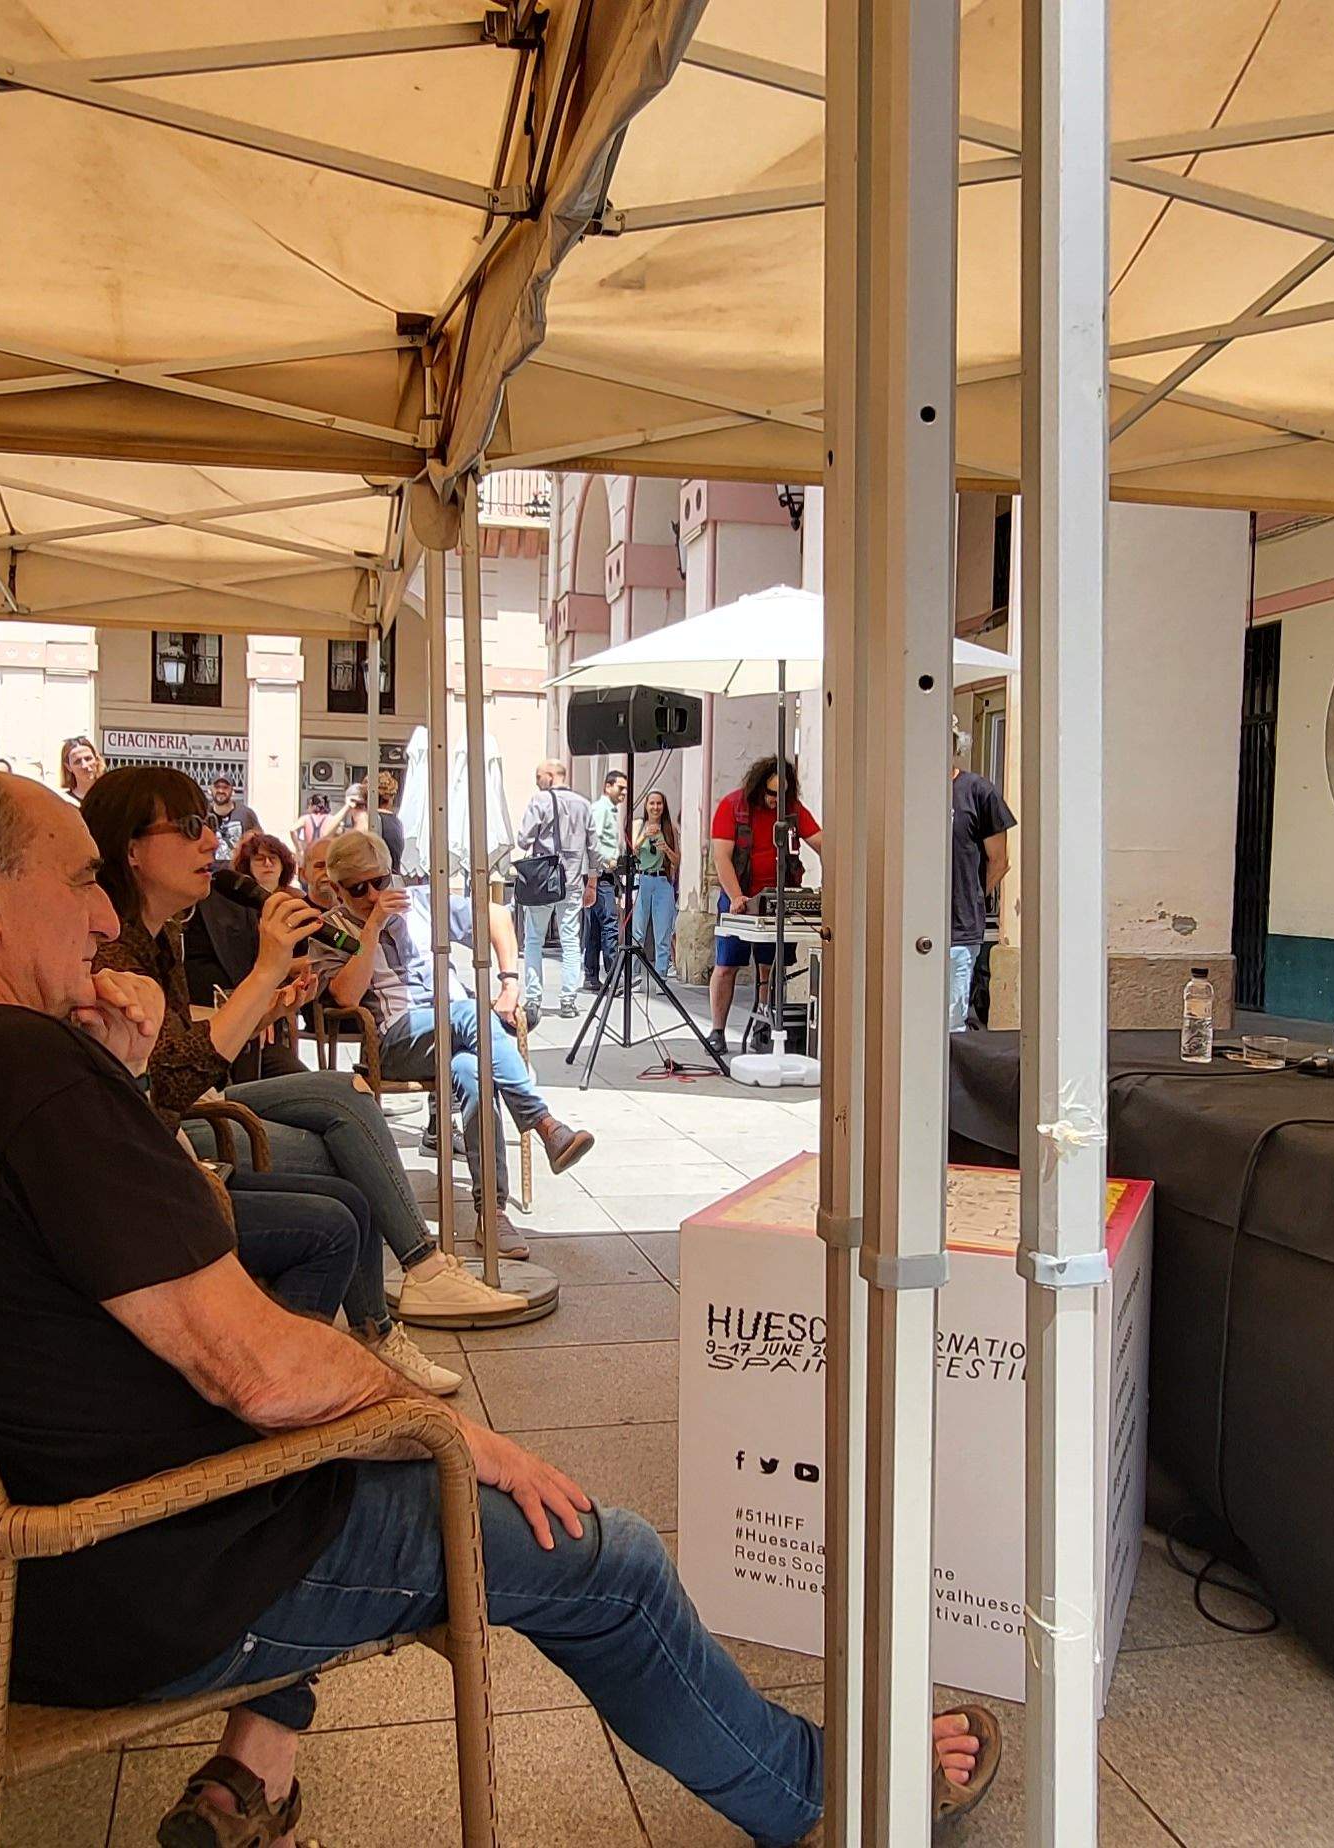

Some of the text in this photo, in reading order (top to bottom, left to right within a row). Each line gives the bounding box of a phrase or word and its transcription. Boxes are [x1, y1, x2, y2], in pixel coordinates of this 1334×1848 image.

[108, 732, 188, 750] CHACINERIA
[708, 1303, 826, 1344] HUESC
[706, 1340, 751, 1357] 9-17
[756, 1343, 805, 1357] JUNE
[735, 1507, 805, 1531] #51HIFF
[735, 1526, 826, 1556] #Huescala
[734, 1544, 787, 1567] Redes
